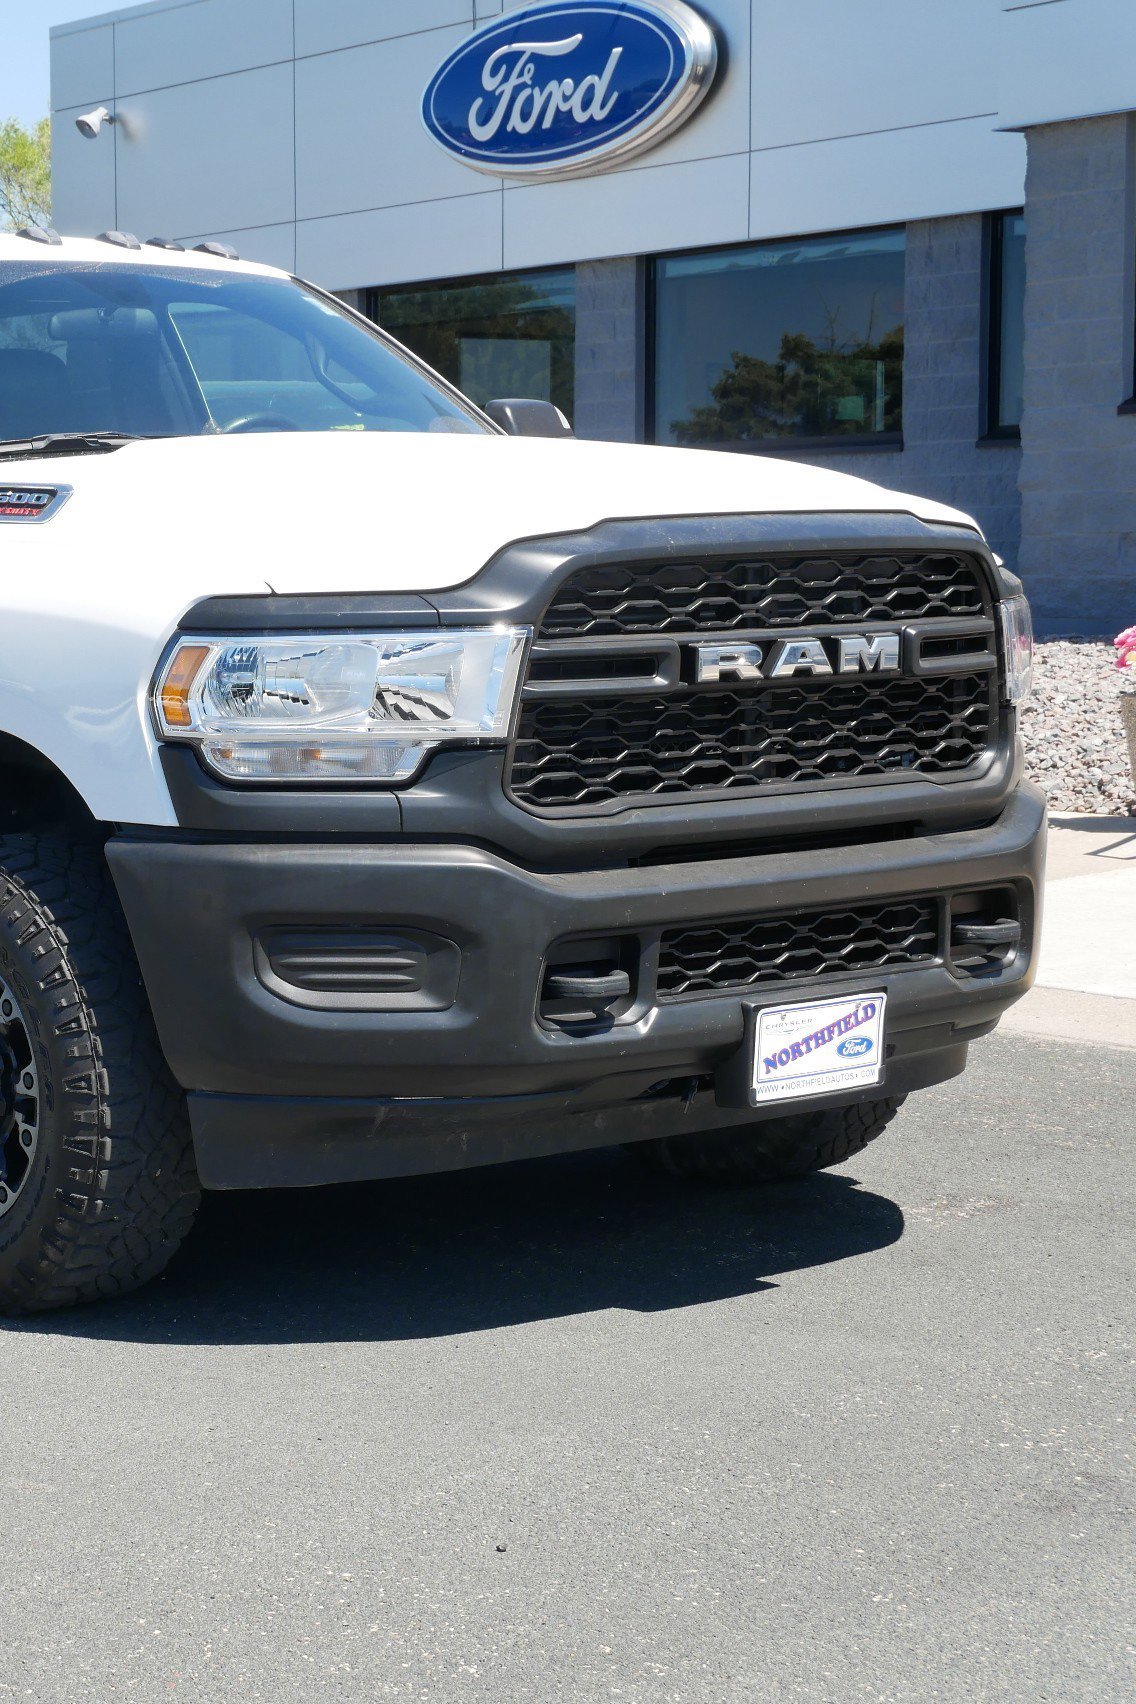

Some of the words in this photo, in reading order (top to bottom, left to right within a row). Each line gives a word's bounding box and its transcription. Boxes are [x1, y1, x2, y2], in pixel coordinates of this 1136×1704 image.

[468, 33, 623, 142] Ford
[689, 633, 901, 683] RAM
[763, 1002, 876, 1075] NORTHFIELD
[842, 1038, 867, 1055] Ford
